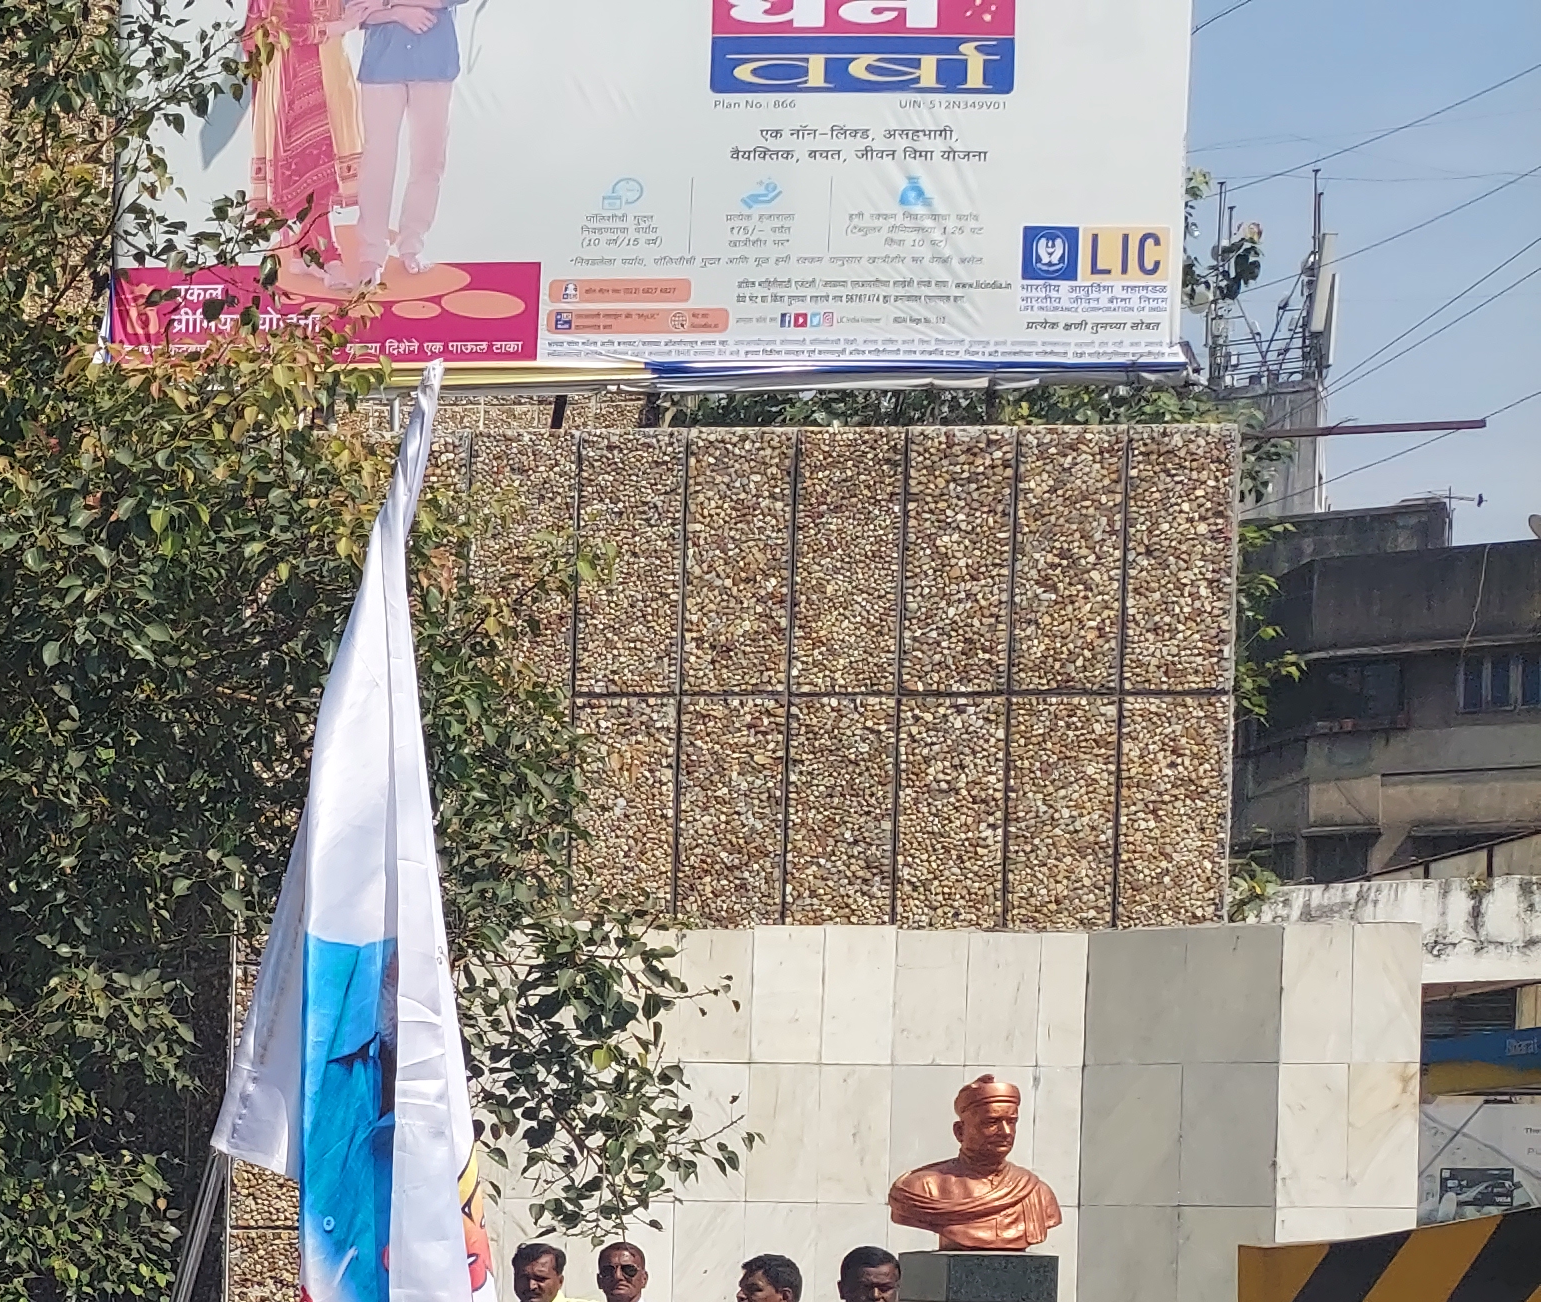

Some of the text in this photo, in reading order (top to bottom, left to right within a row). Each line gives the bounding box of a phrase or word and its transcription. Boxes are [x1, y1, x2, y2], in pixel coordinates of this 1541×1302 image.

[726, 41, 1000, 88] वर्षा
[714, 100, 741, 109] Plan
[773, 100, 796, 109] 866
[760, 128, 783, 141] एक
[730, 147, 989, 164] वैयक्तिक, बचत, जीवन विमा योजना
[1091, 232, 1162, 276] LIC
[1020, 282, 1061, 294] भारतीय
[1020, 294, 1168, 306] भारतीय जीवन बीमा निगम
[385, 338, 420, 356] दिशेने
[423, 341, 445, 356] एक
[448, 340, 489, 355] पाऊल
[492, 340, 524, 354] टाका
